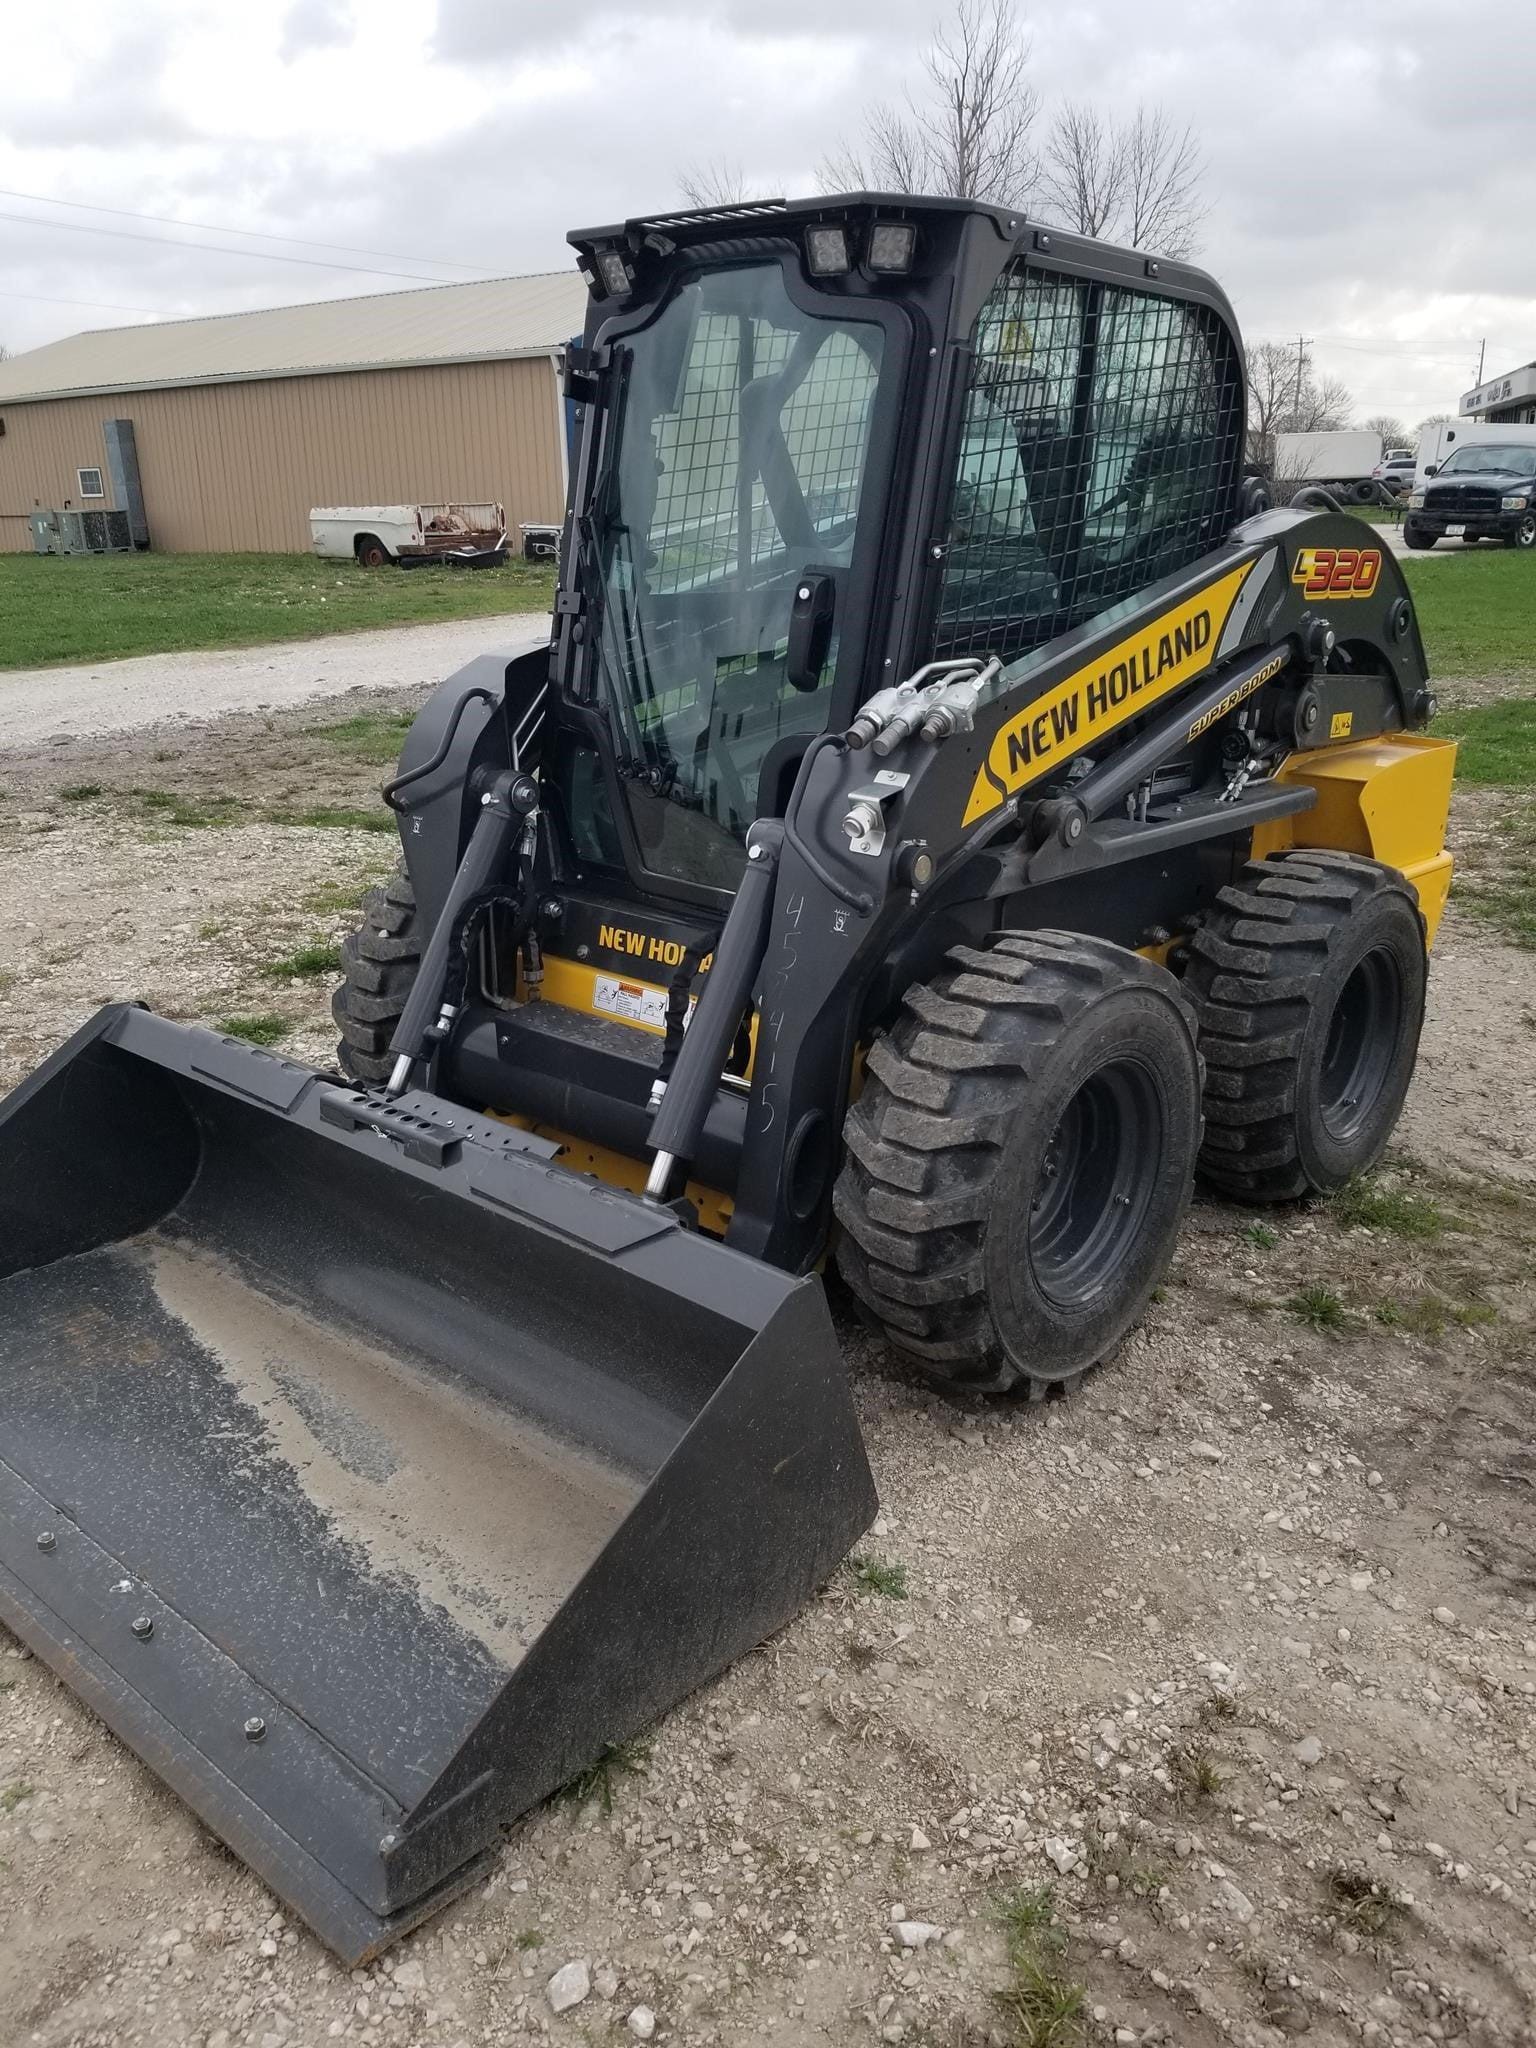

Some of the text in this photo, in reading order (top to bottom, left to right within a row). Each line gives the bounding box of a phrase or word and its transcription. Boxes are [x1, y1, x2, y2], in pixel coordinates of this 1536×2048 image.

[1292, 549, 1382, 600] L320
[1007, 609, 1211, 775] NEW HOLLAND
[1187, 656, 1282, 743] SUPER BOOM
[599, 924, 645, 957] NEW
